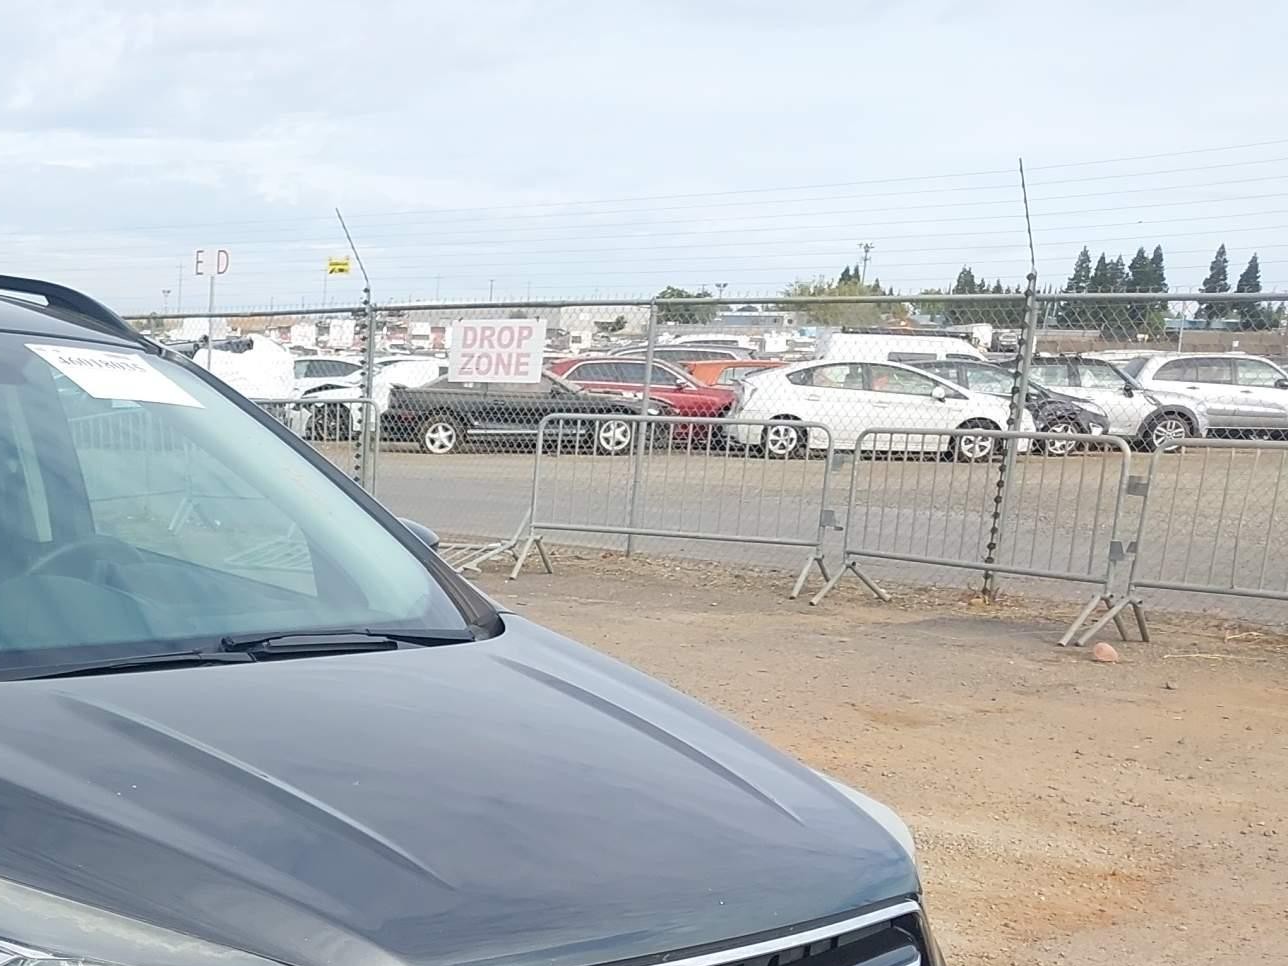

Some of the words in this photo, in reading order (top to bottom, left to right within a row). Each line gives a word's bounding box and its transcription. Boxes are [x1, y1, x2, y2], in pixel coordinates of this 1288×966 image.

[195, 250, 205, 276] E
[216, 250, 229, 274] D
[462, 326, 533, 350] DROP
[458, 352, 530, 377] ZONE
